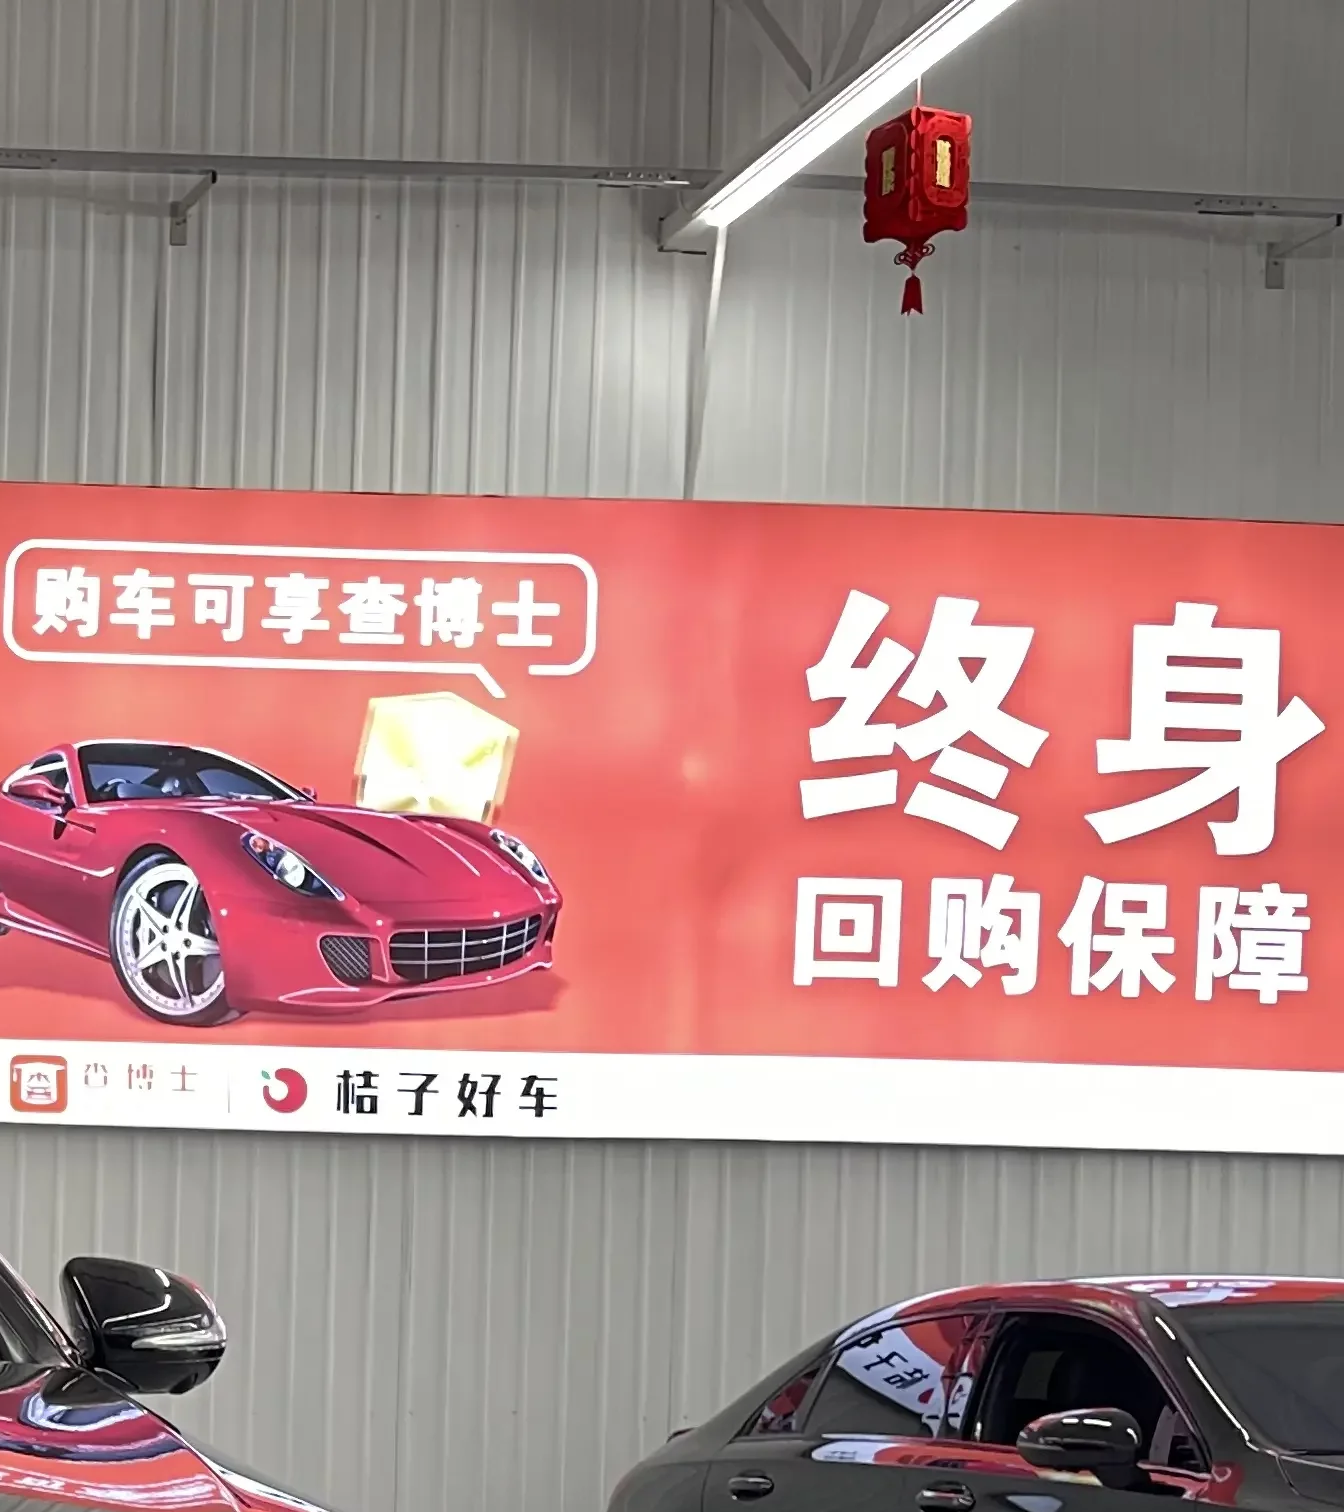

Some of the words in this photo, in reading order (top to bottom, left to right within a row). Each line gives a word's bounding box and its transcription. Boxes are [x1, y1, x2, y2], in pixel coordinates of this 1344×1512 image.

[31, 566, 561, 649] 购车可享查博士
[799, 589, 1326, 856] 终身
[793, 873, 1311, 1004] 回购保障
[336, 1069, 558, 1118] 桔子好车
